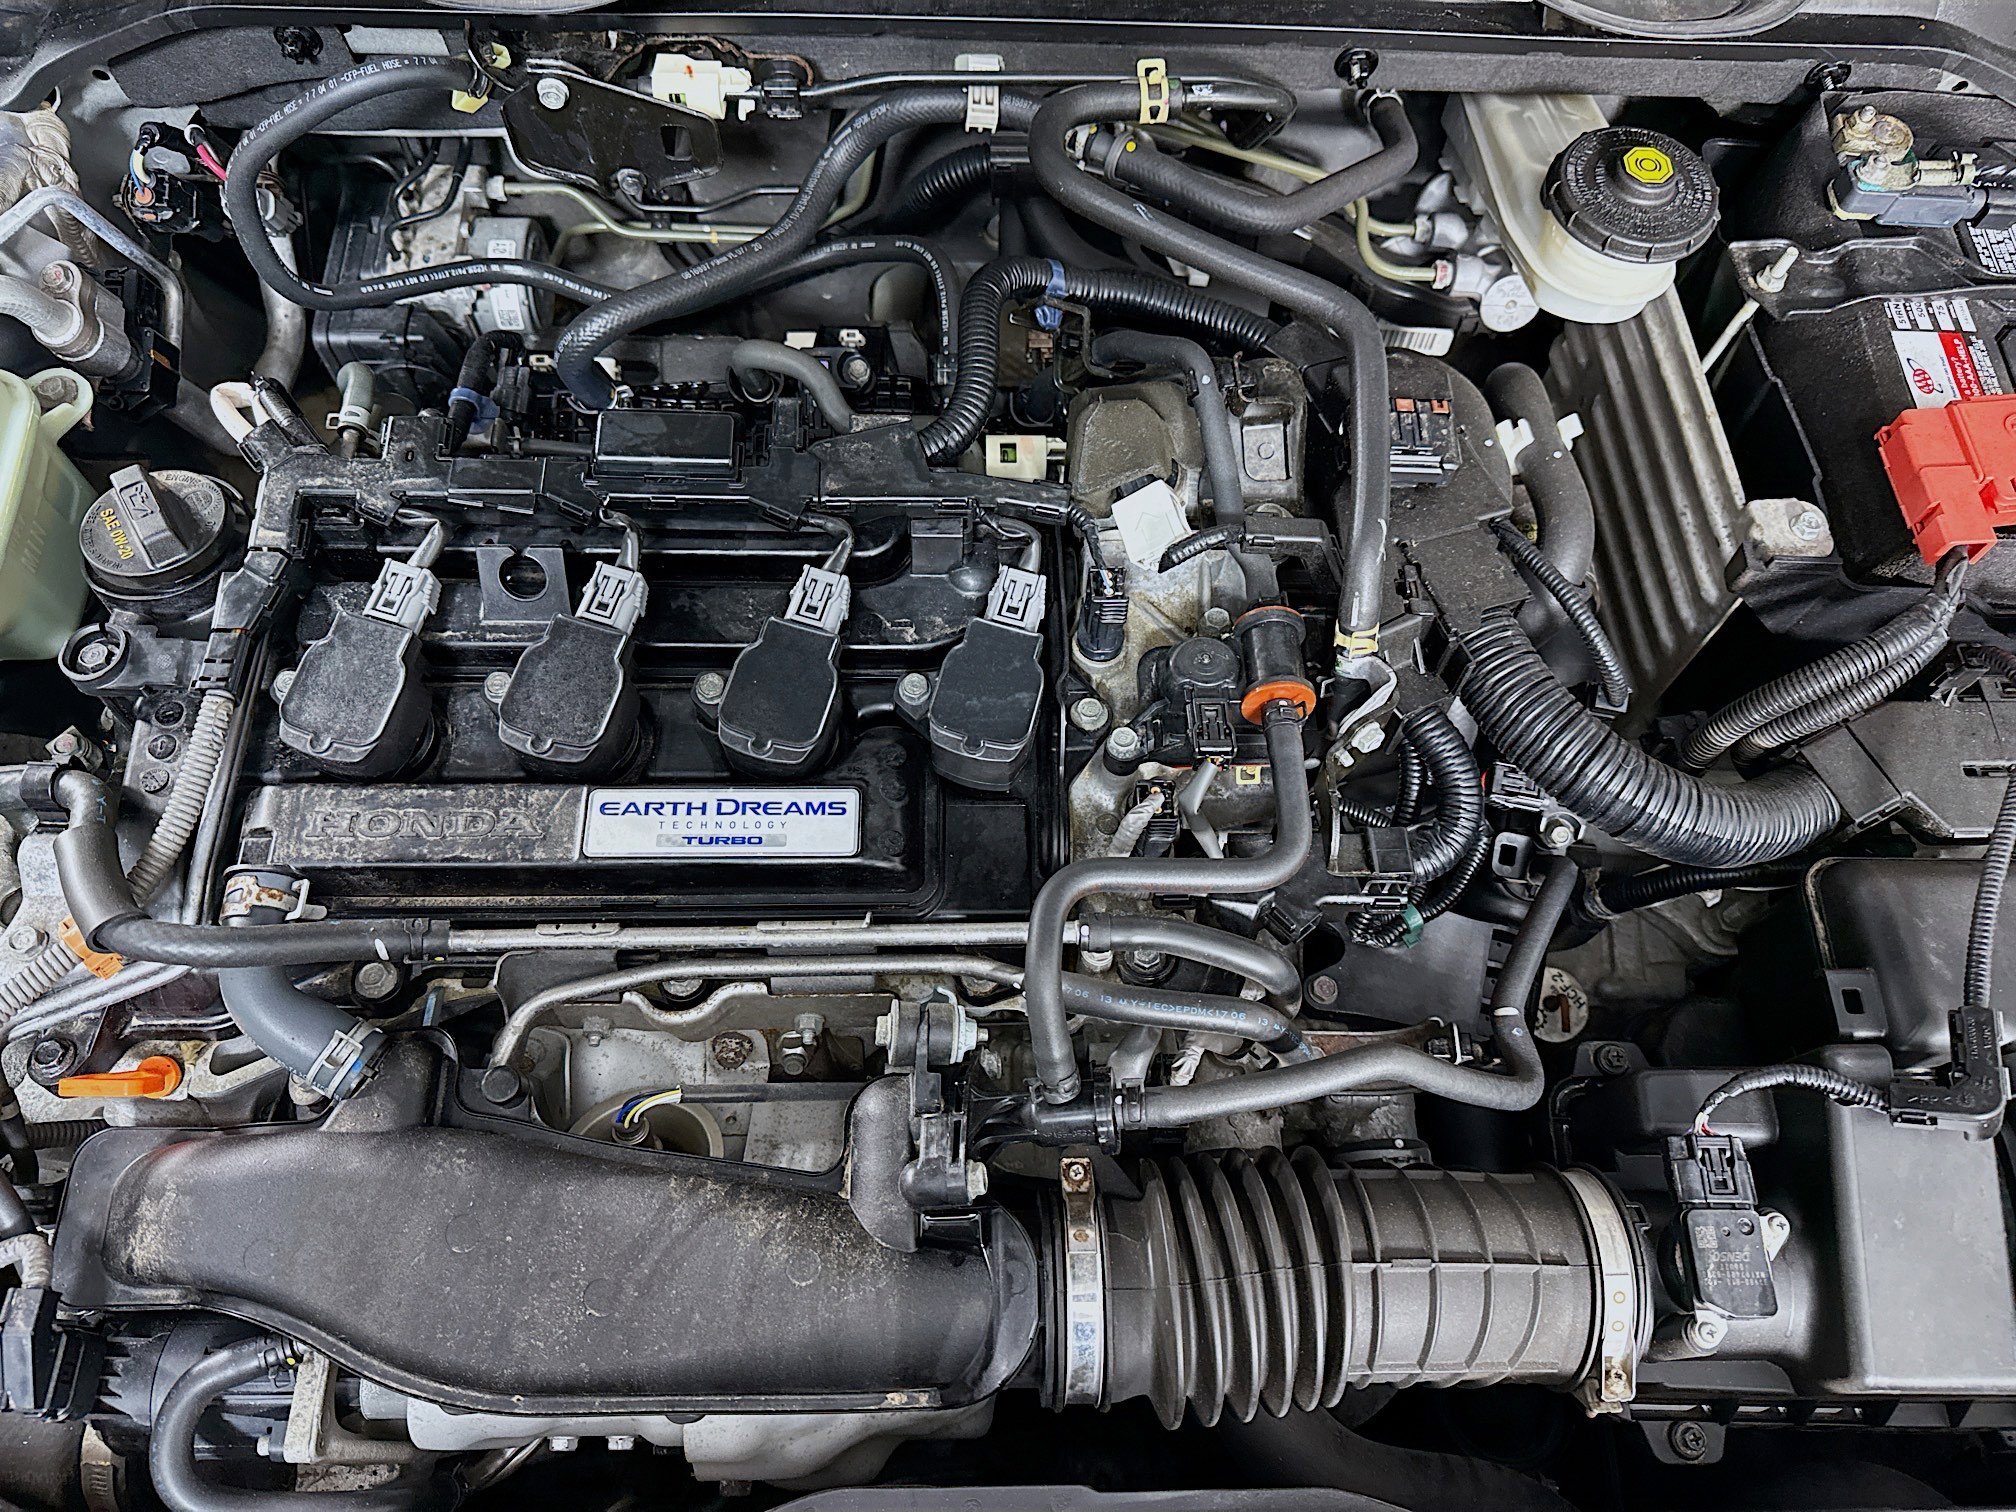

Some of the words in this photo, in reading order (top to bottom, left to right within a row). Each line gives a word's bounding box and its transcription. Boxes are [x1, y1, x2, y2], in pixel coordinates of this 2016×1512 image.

[382, 58, 403, 71] HOSE
[751, 242, 763, 252] 20
[1913, 369, 1935, 394] AAA
[100, 508, 120, 532] SAE
[110, 526, 135, 561] 0W-20
[600, 801, 707, 816] EARTH
[716, 799, 847, 816] DREAMS
[305, 808, 546, 838] HONDA
[659, 821, 788, 830] TECHNOLOGY
[681, 836, 763, 845] TURBO
[1551, 971, 1586, 1009] HCF-2
[1231, 1011, 1247, 1020] 06
